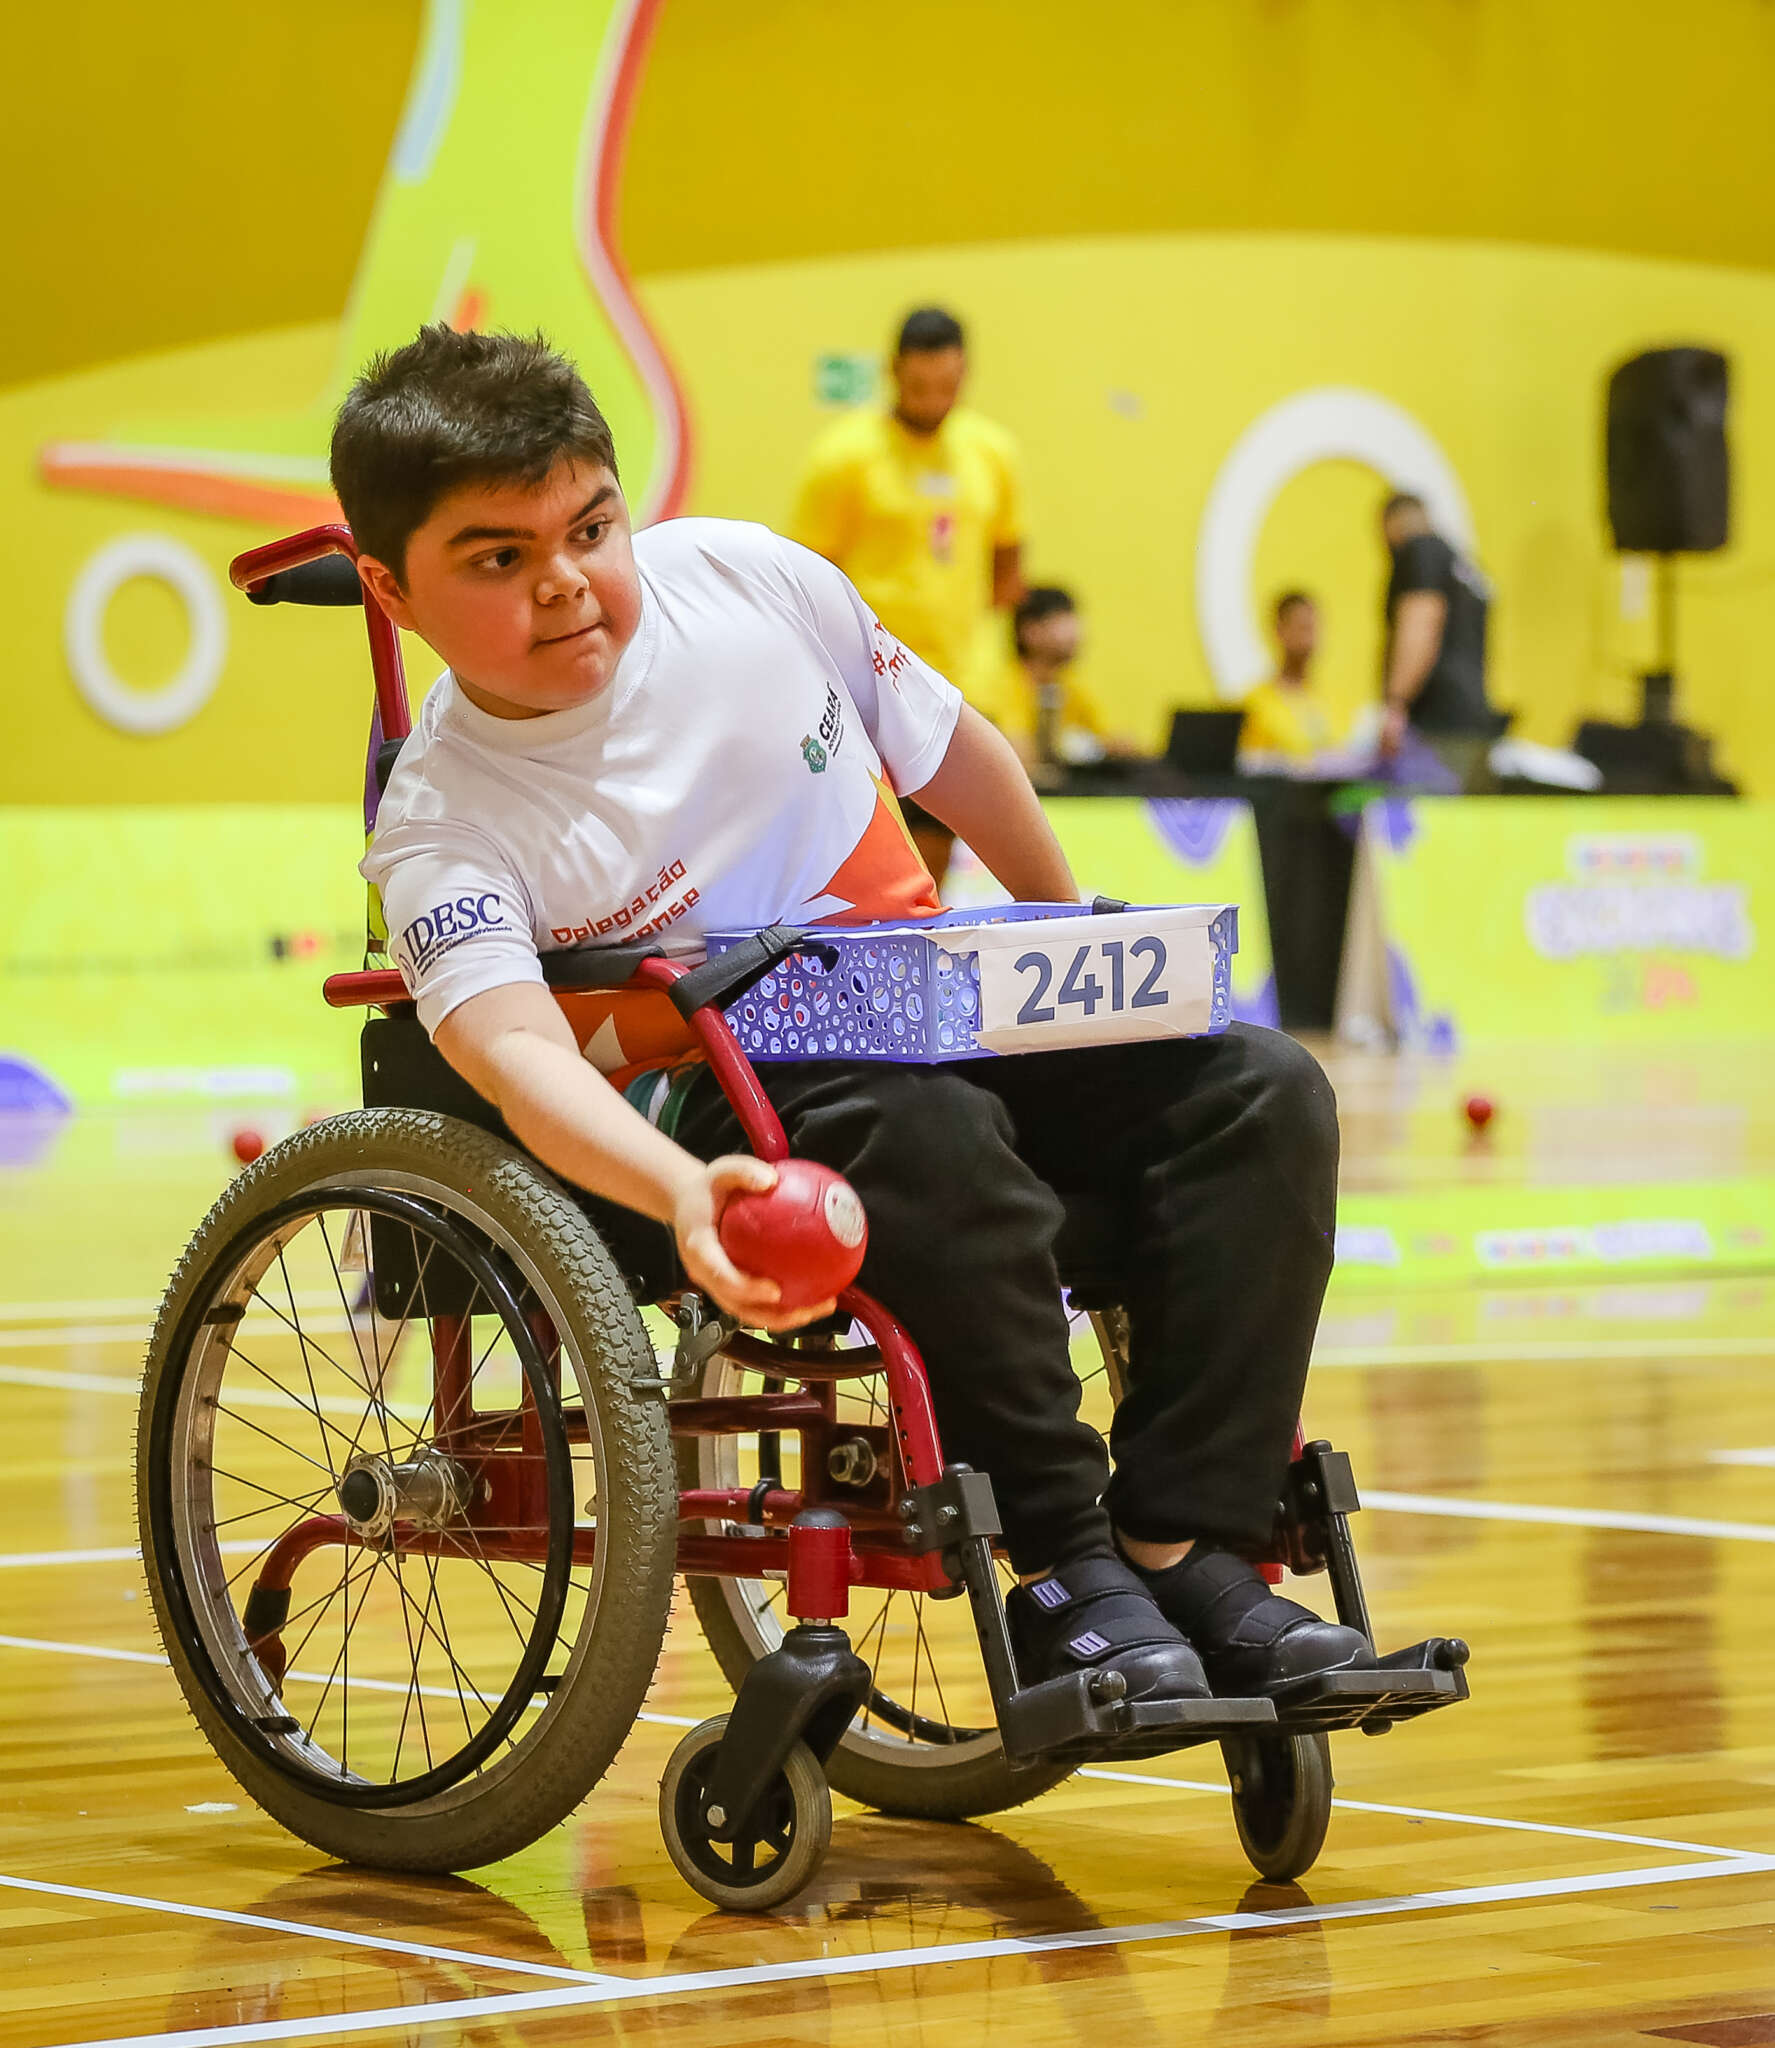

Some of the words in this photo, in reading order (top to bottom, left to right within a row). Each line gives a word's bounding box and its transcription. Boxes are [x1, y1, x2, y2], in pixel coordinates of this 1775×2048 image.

[819, 681, 838, 741] CEARÁ
[402, 893, 504, 966] IDESC
[551, 859, 687, 943] Delegação
[1013, 936, 1169, 1025] 2412
